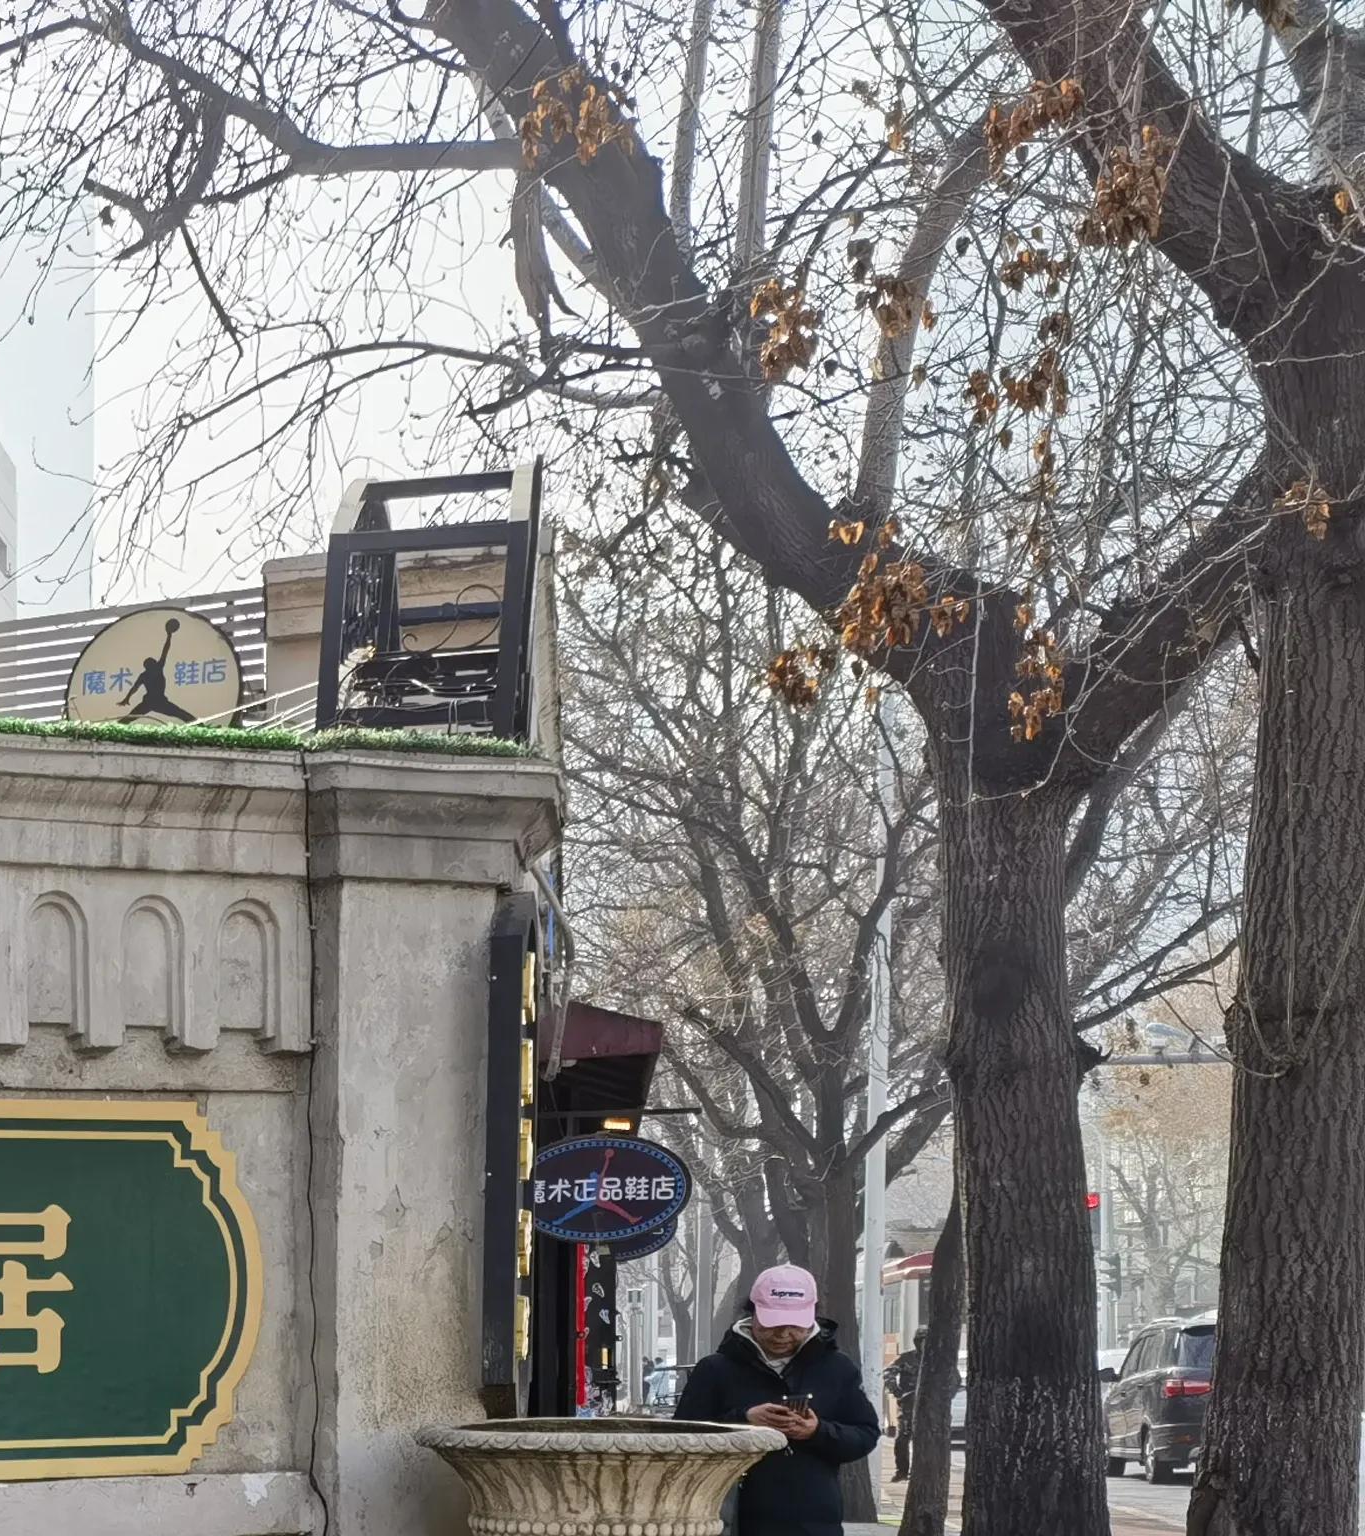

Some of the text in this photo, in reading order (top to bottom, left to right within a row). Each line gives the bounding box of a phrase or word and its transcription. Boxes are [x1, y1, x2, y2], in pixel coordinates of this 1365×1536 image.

[82, 658, 227, 696] 魔术 鞋店
[770, 1288, 805, 1299] Supreme
